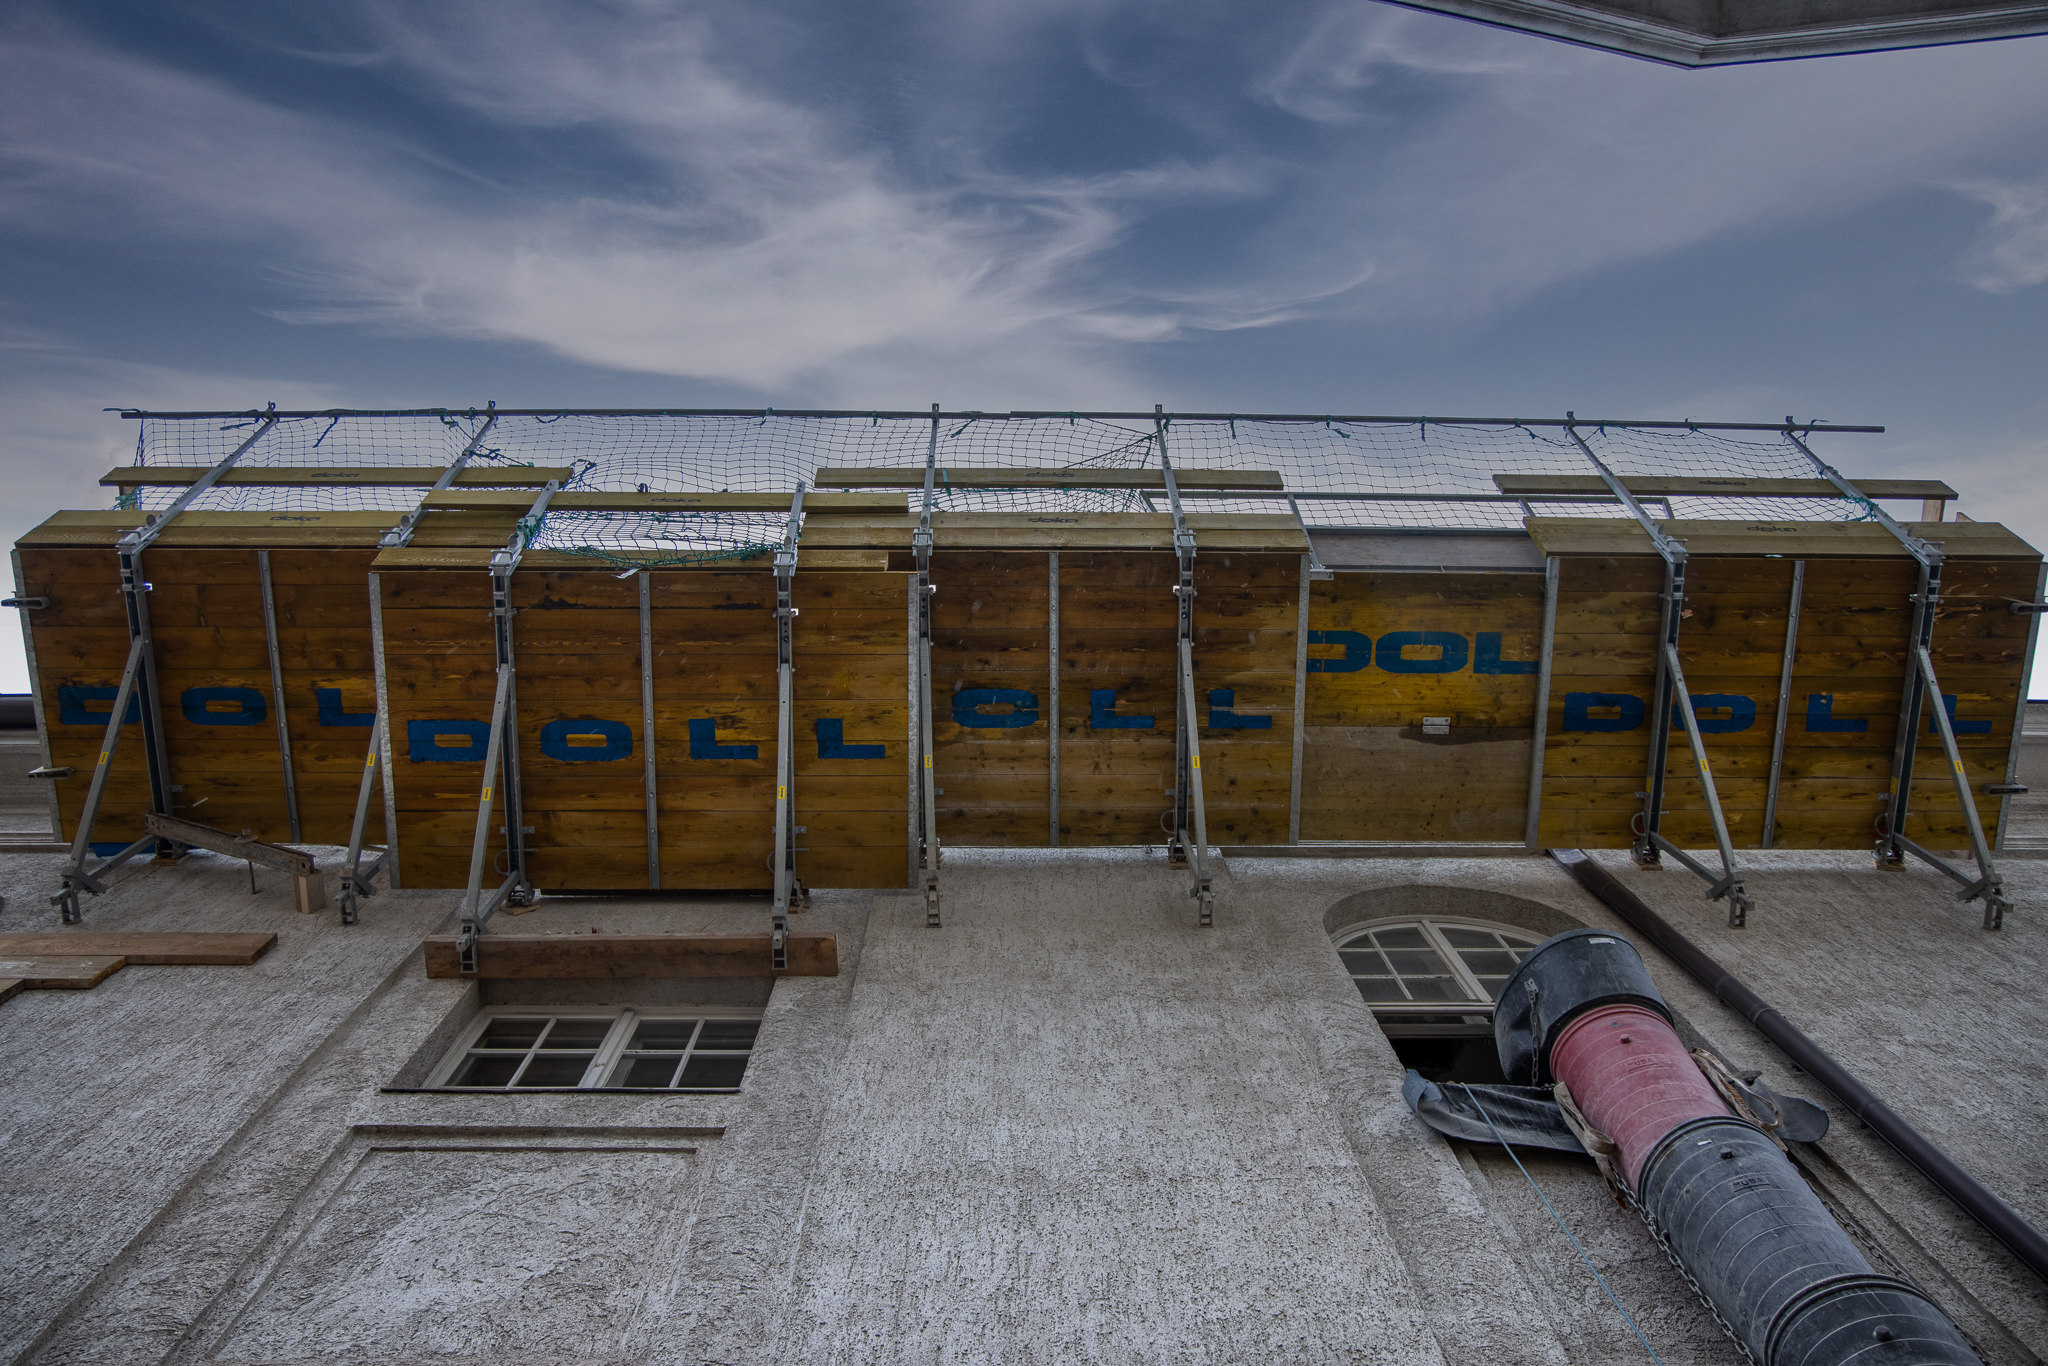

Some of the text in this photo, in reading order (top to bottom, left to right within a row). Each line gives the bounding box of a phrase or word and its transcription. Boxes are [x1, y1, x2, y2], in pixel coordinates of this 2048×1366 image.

[310, 471, 360, 479] doka
[1698, 479, 1747, 487] doka
[269, 514, 322, 522] doka
[1027, 516, 1079, 524] doka
[1746, 525, 1798, 533] doka
[1562, 691, 1993, 734] DOLL
[407, 718, 887, 763] DOLL
